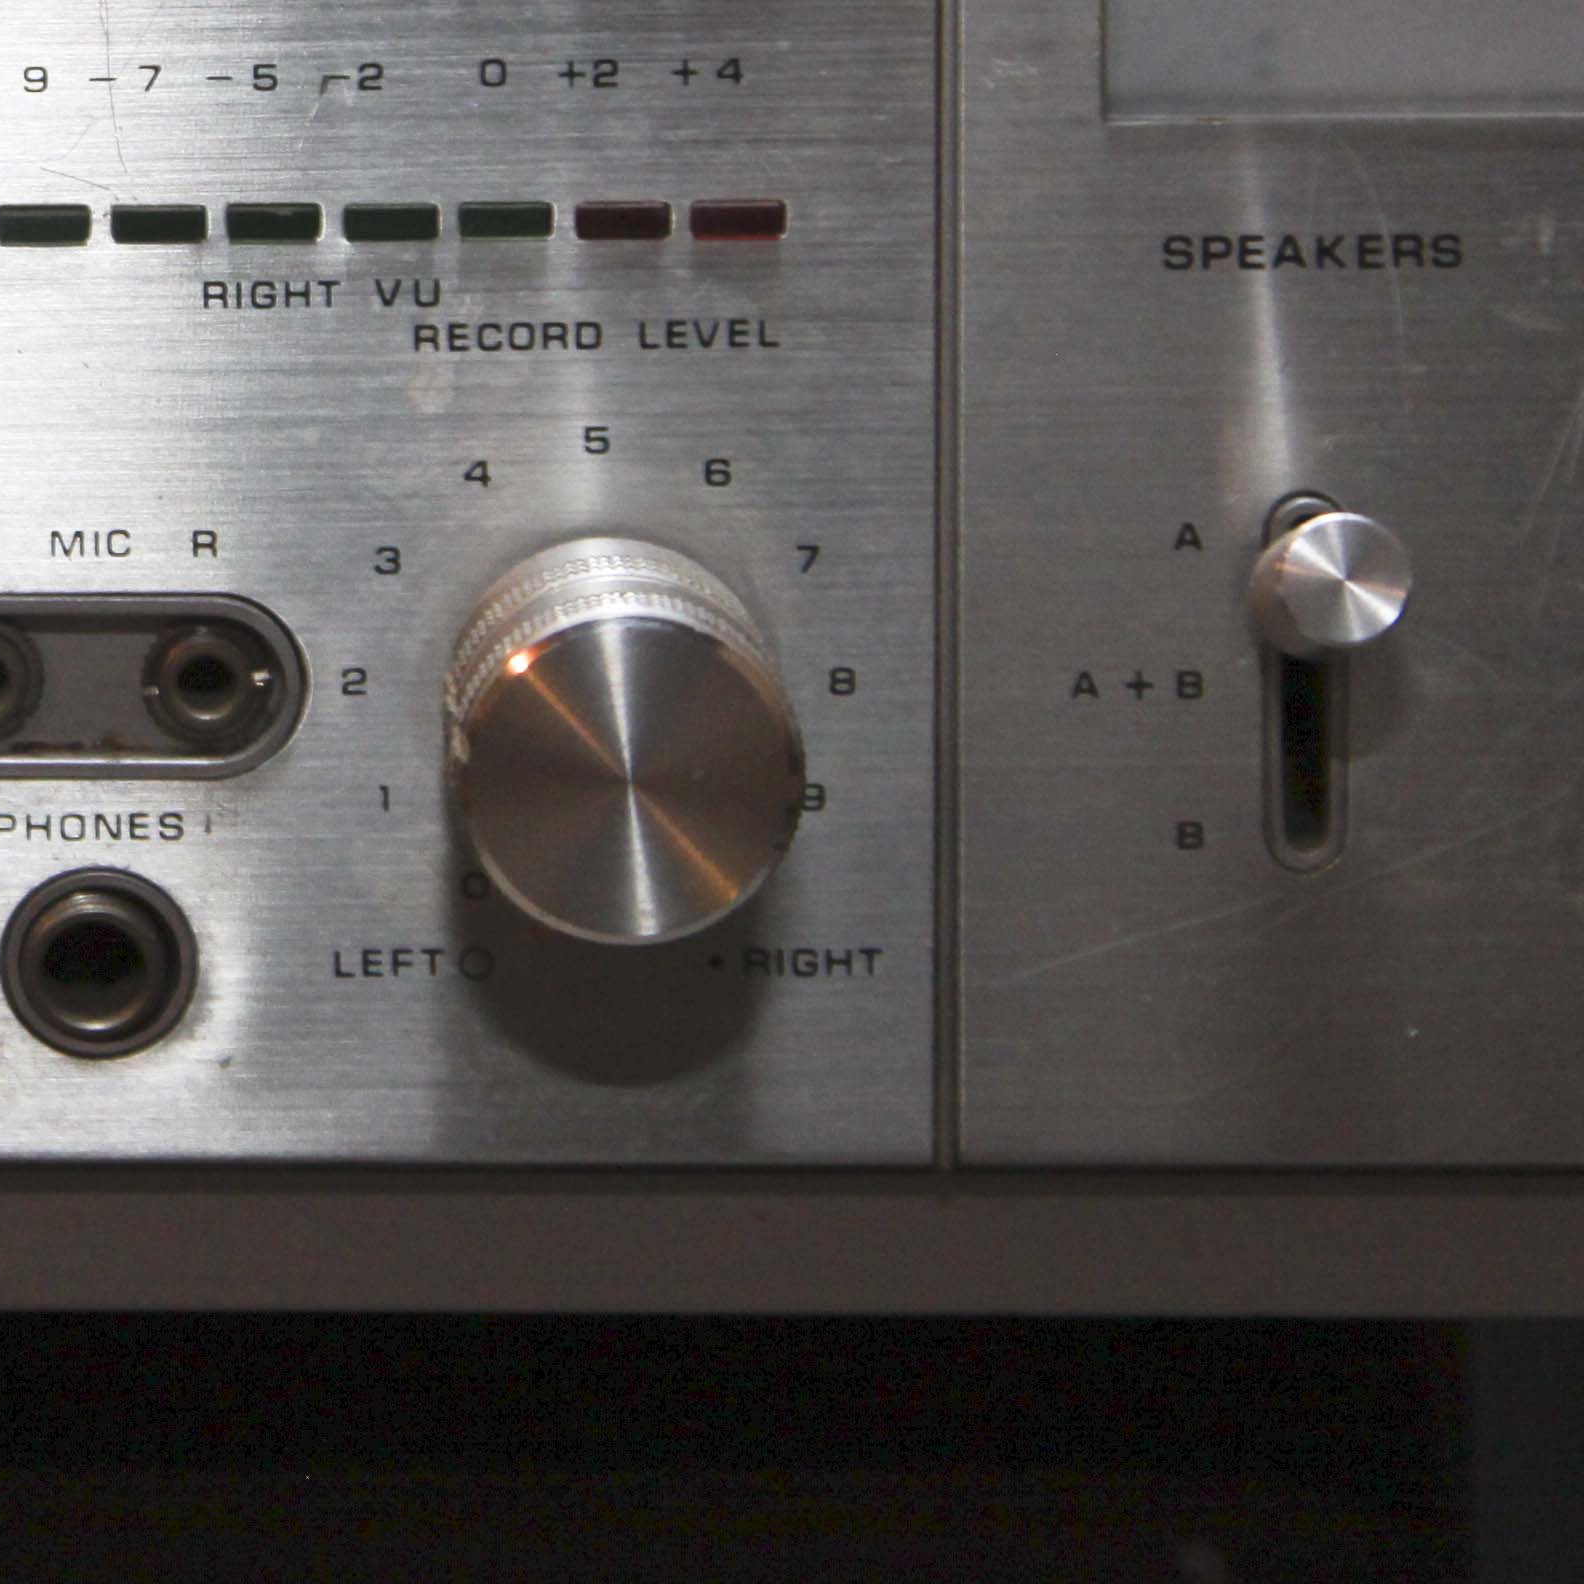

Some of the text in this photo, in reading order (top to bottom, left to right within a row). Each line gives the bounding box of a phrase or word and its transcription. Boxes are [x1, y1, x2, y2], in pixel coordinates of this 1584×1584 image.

[477, 56, 509, 90] 0
[1160, 232, 1466, 272] SPEAKERS
[201, 277, 444, 311] RIGHT VU
[412, 318, 780, 354] RECORD LEVEL
[586, 426, 611, 456] 5
[462, 458, 493, 489] 4
[703, 458, 732, 489] 6
[48, 529, 132, 559] MIC
[190, 529, 220, 559] R
[1173, 522, 1204, 552] A
[372, 546, 402, 578] 3
[795, 544, 822, 576] 7
[340, 666, 368, 698] 2
[829, 665, 858, 697] 8
[376, 782, 392, 813] 1
[800, 782, 827, 813] 9
[1176, 820, 1205, 850] B
[333, 948, 444, 980] LEFT
[740, 946, 884, 979] RIGHT
